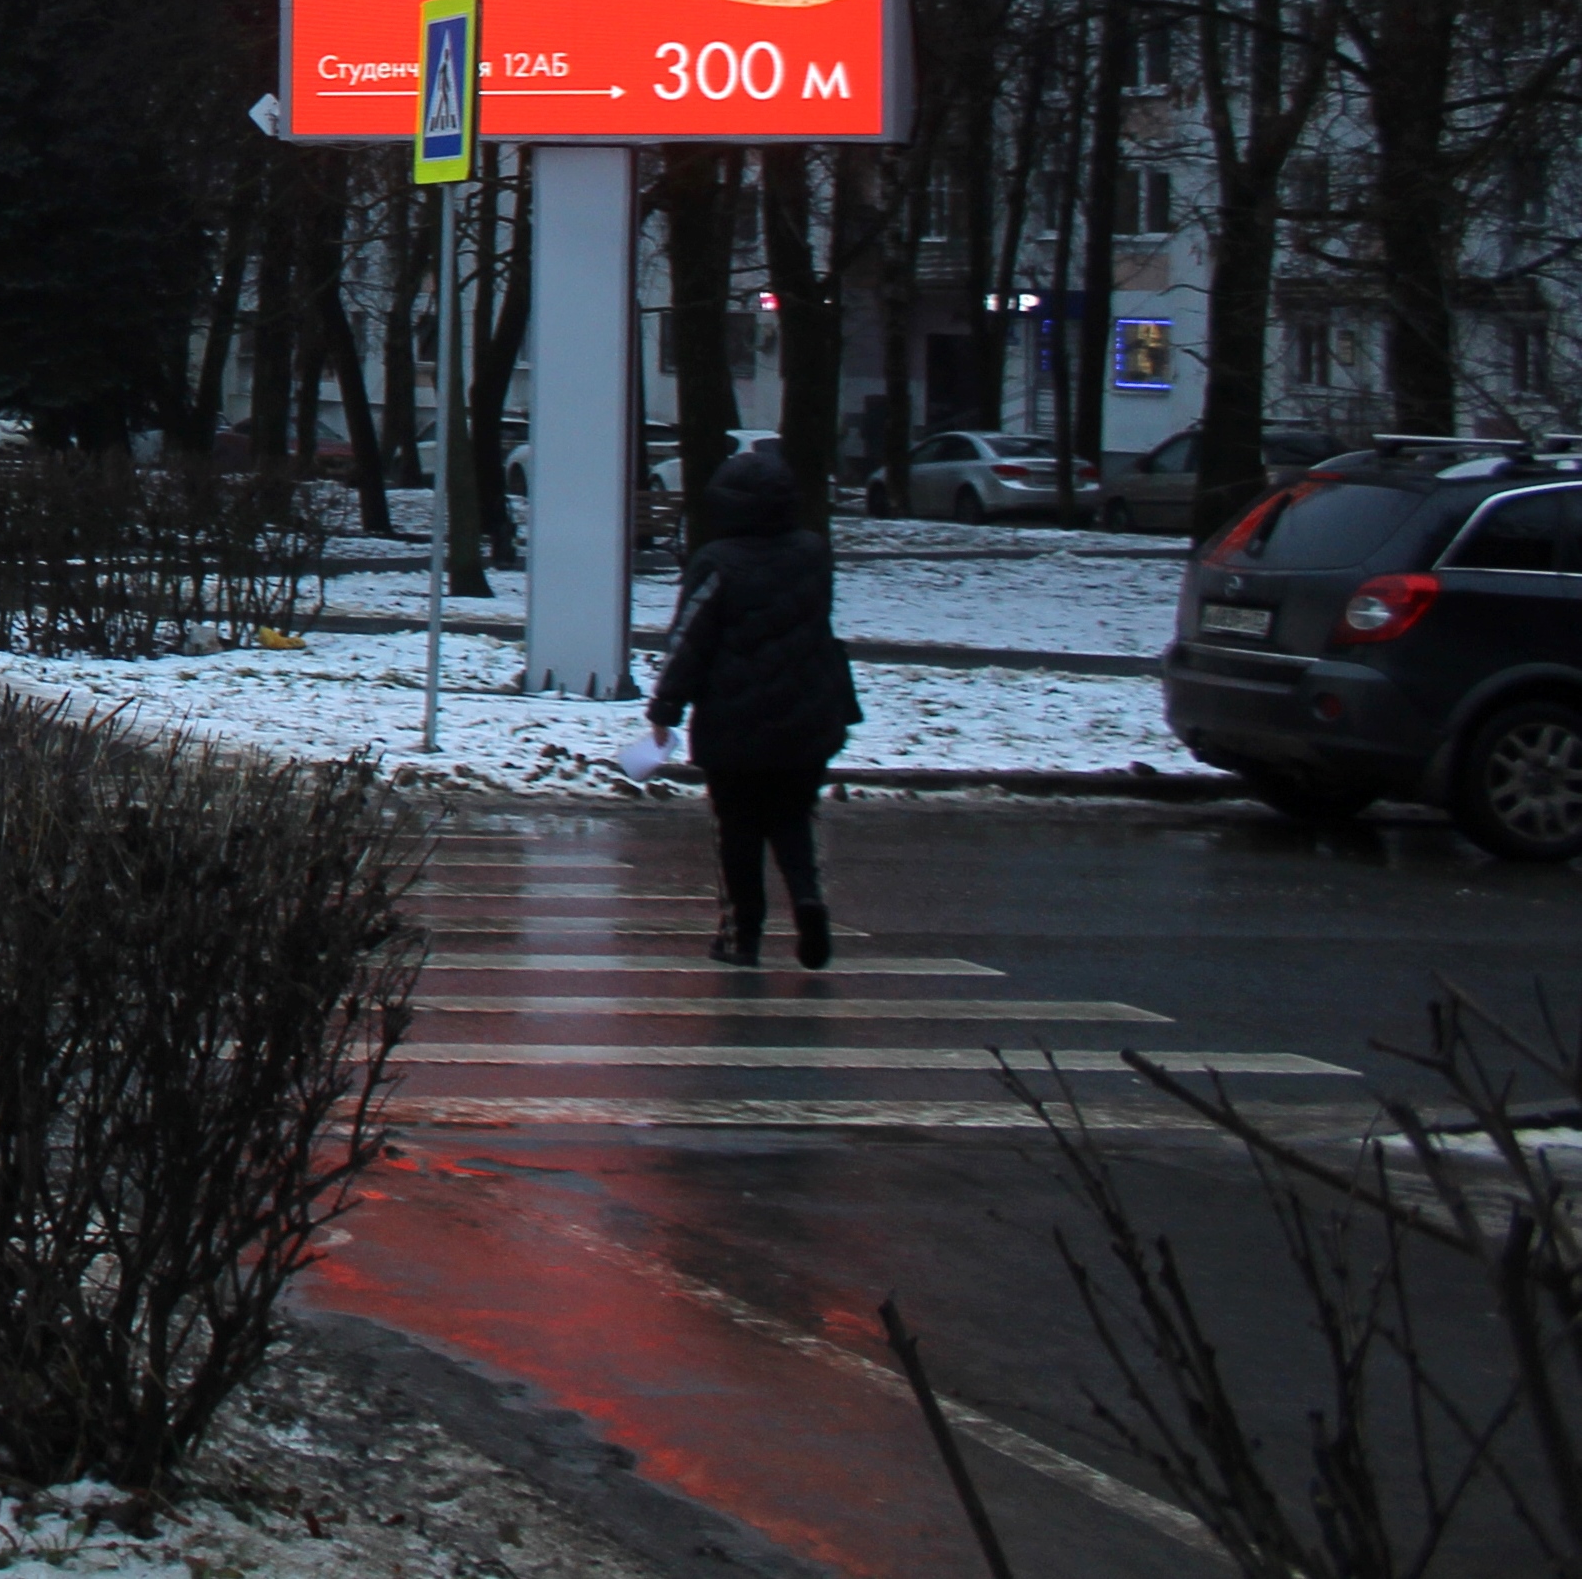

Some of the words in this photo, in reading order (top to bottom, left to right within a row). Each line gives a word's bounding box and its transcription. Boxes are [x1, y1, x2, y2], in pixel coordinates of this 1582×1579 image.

[503, 52, 570, 79] 12АБ
[653, 41, 783, 101] 300
[801, 61, 852, 100] м
